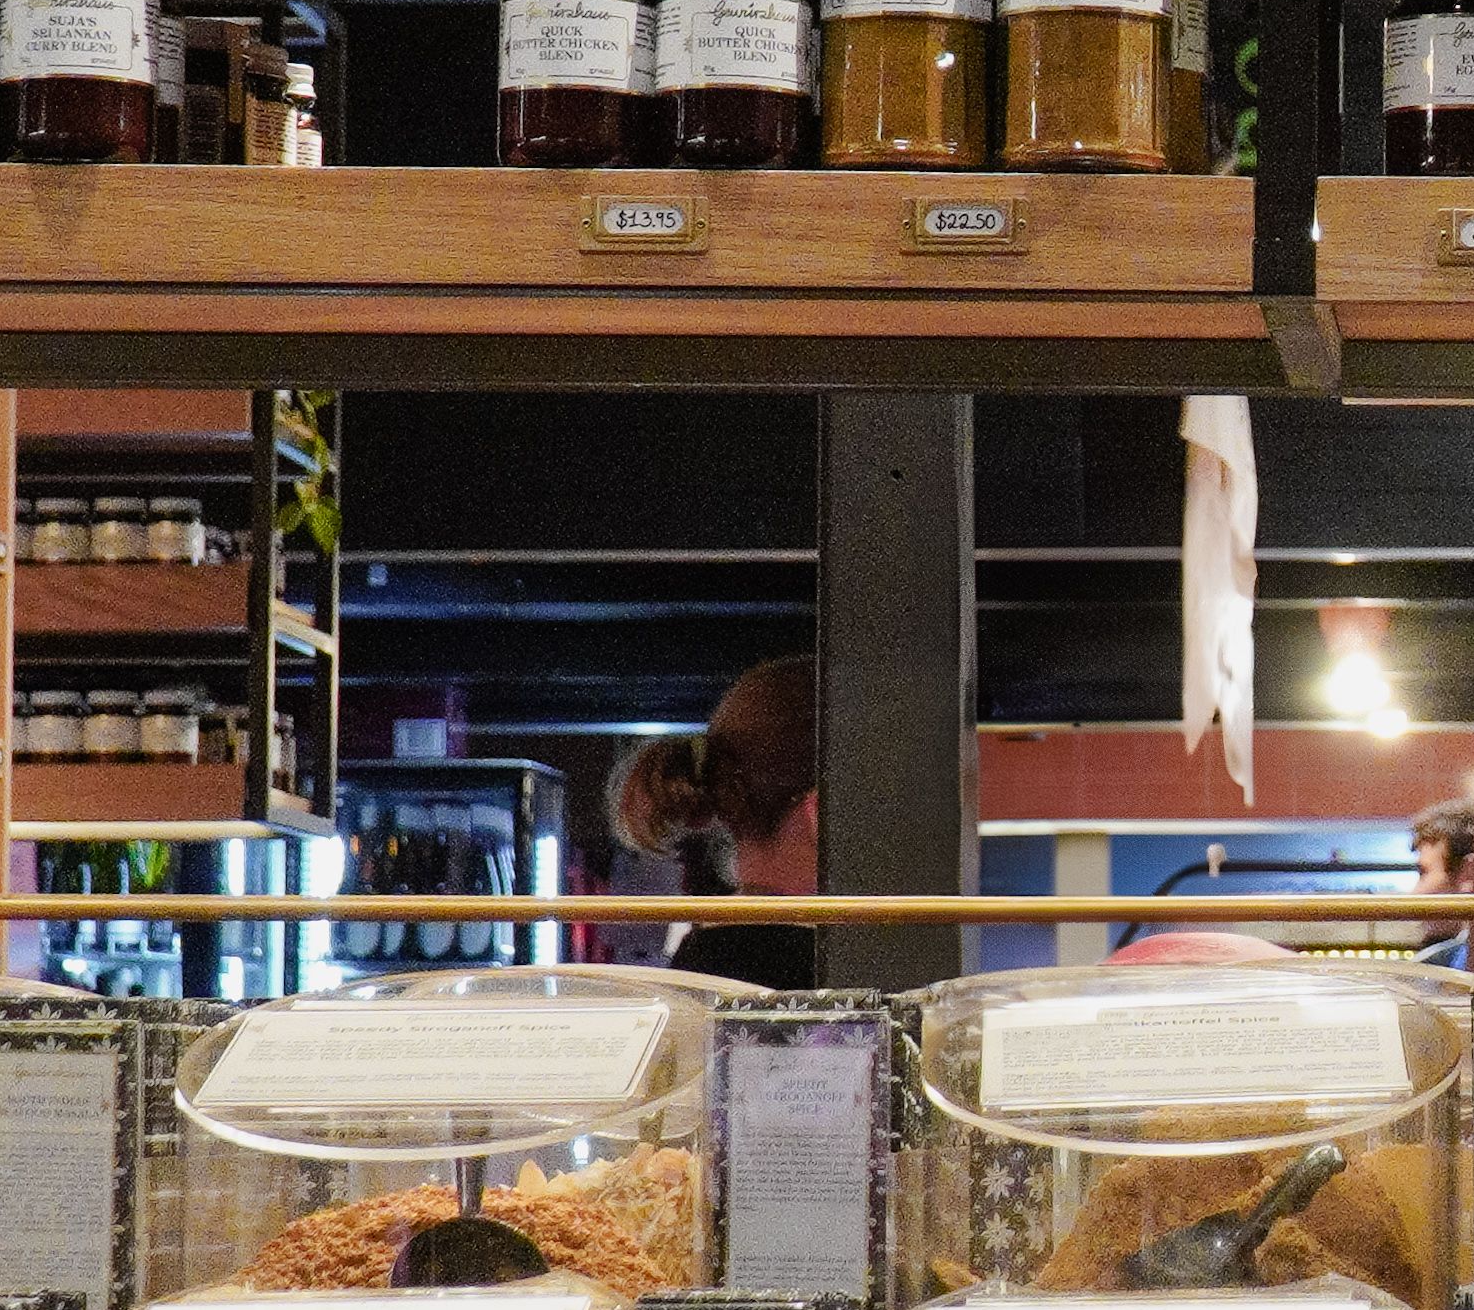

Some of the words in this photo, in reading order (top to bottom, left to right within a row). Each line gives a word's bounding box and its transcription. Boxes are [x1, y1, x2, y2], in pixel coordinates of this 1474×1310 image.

[48, 15, 98, 28] SUJA'S
[54, 27, 113, 41] LANKAN
[25, 40, 65, 54] CURRY
[67, 41, 119, 55] BLEND
[615, 211, 678, 230] $13.95
[936, 213, 998, 231] $22.50
[410, 1021, 516, 1034] Stroganoff
[519, 1021, 572, 1033] Spice
